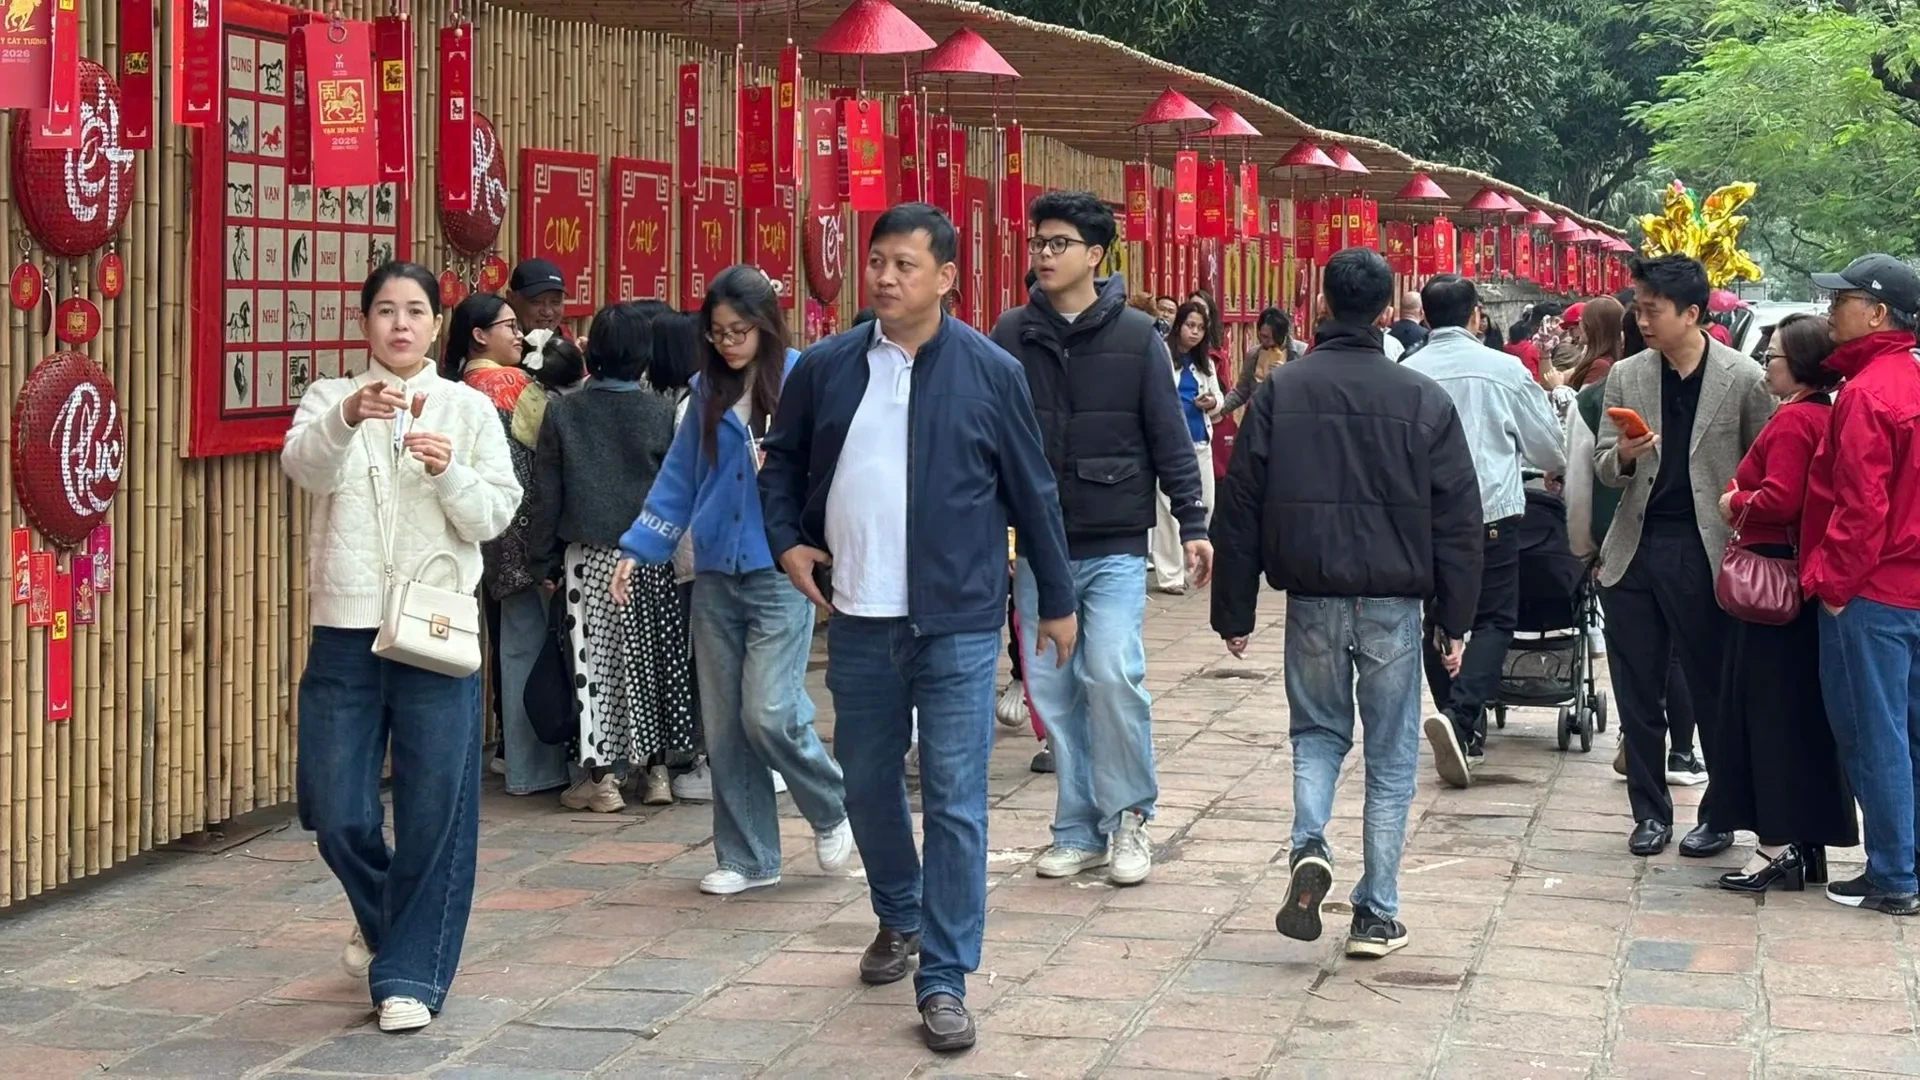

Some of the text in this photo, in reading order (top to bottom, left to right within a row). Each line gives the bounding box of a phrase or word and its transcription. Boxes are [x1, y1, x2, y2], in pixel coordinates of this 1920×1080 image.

[2, 49, 30, 58] 2026
[332, 137, 357, 145] 2026
[263, 186, 280, 204] VẠN
[265, 248, 276, 266] SỰ
